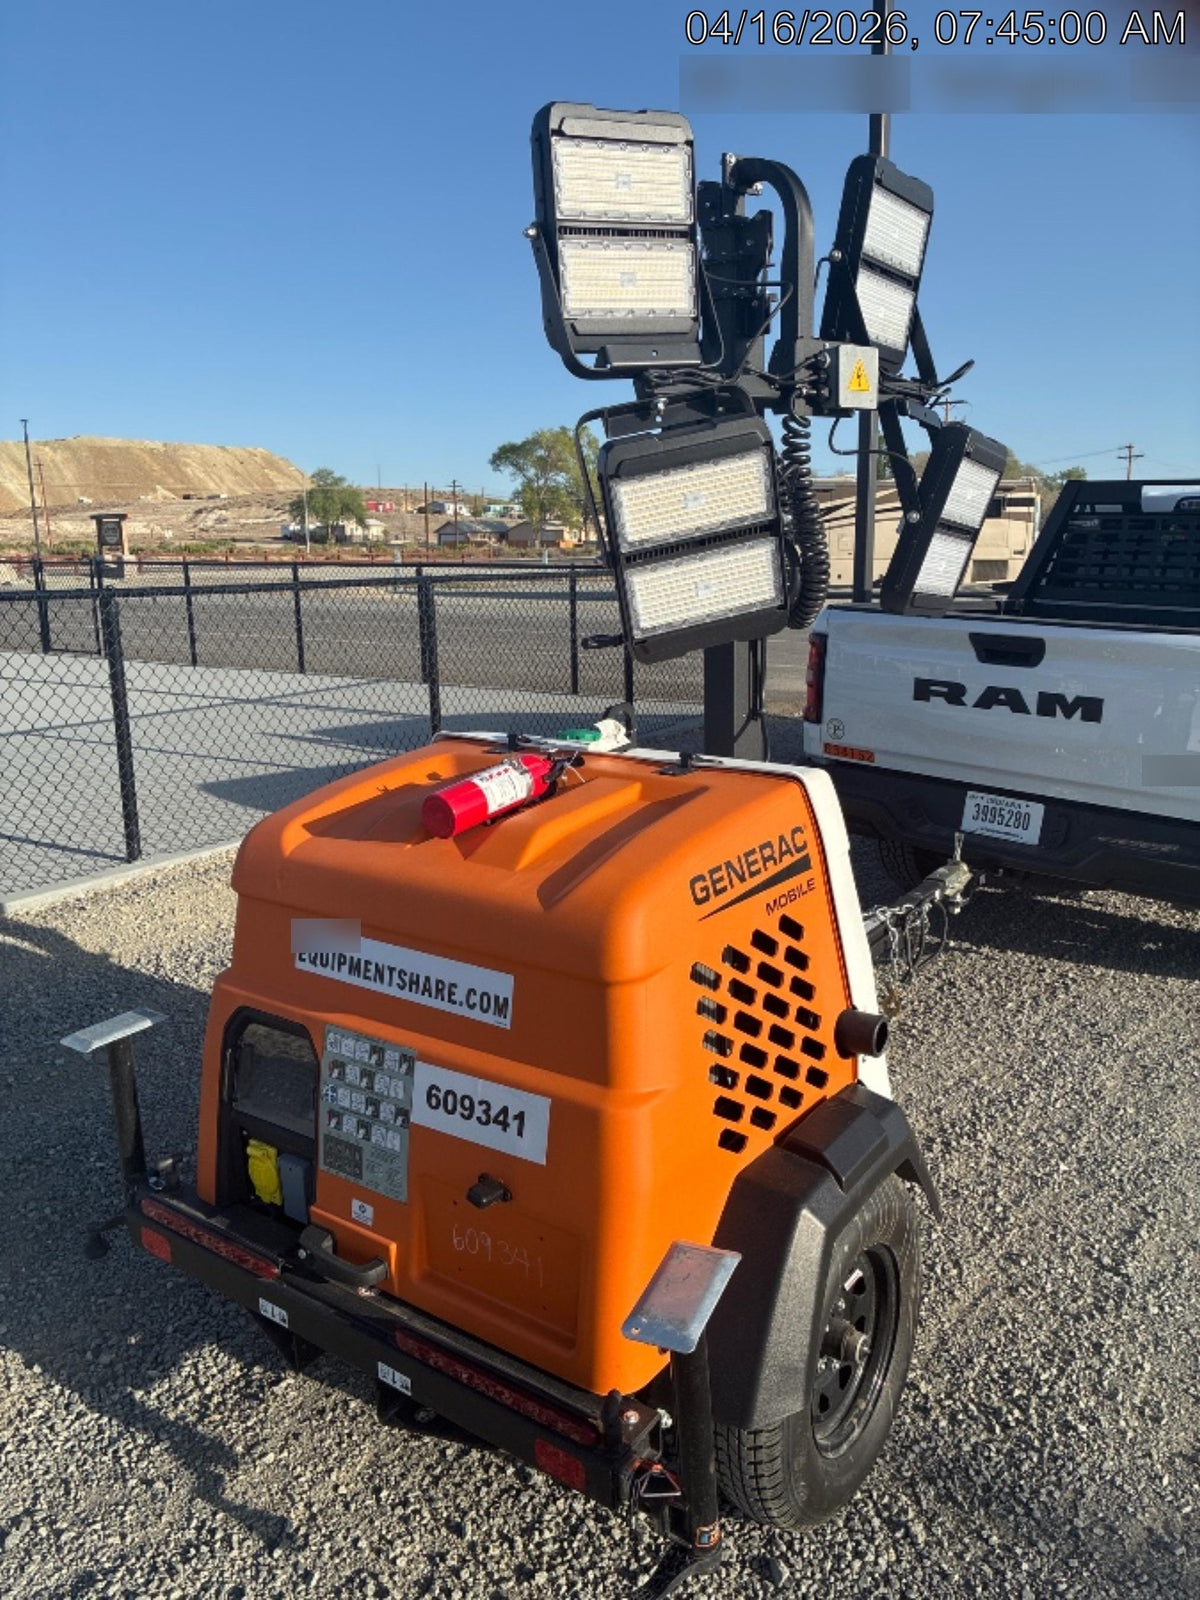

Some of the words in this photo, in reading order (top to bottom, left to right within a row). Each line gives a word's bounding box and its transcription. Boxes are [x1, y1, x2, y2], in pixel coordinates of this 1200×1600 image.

[913, 677, 1104, 723] RAM
[971, 803, 1031, 831] 3995280
[689, 826, 808, 906] GENERAC
[765, 878, 816, 917] MOBILE
[297, 951, 510, 1019] EQUIPMENTSHARE.COM
[426, 1083, 526, 1138] 609341
[452, 1223, 544, 1289] 609341
